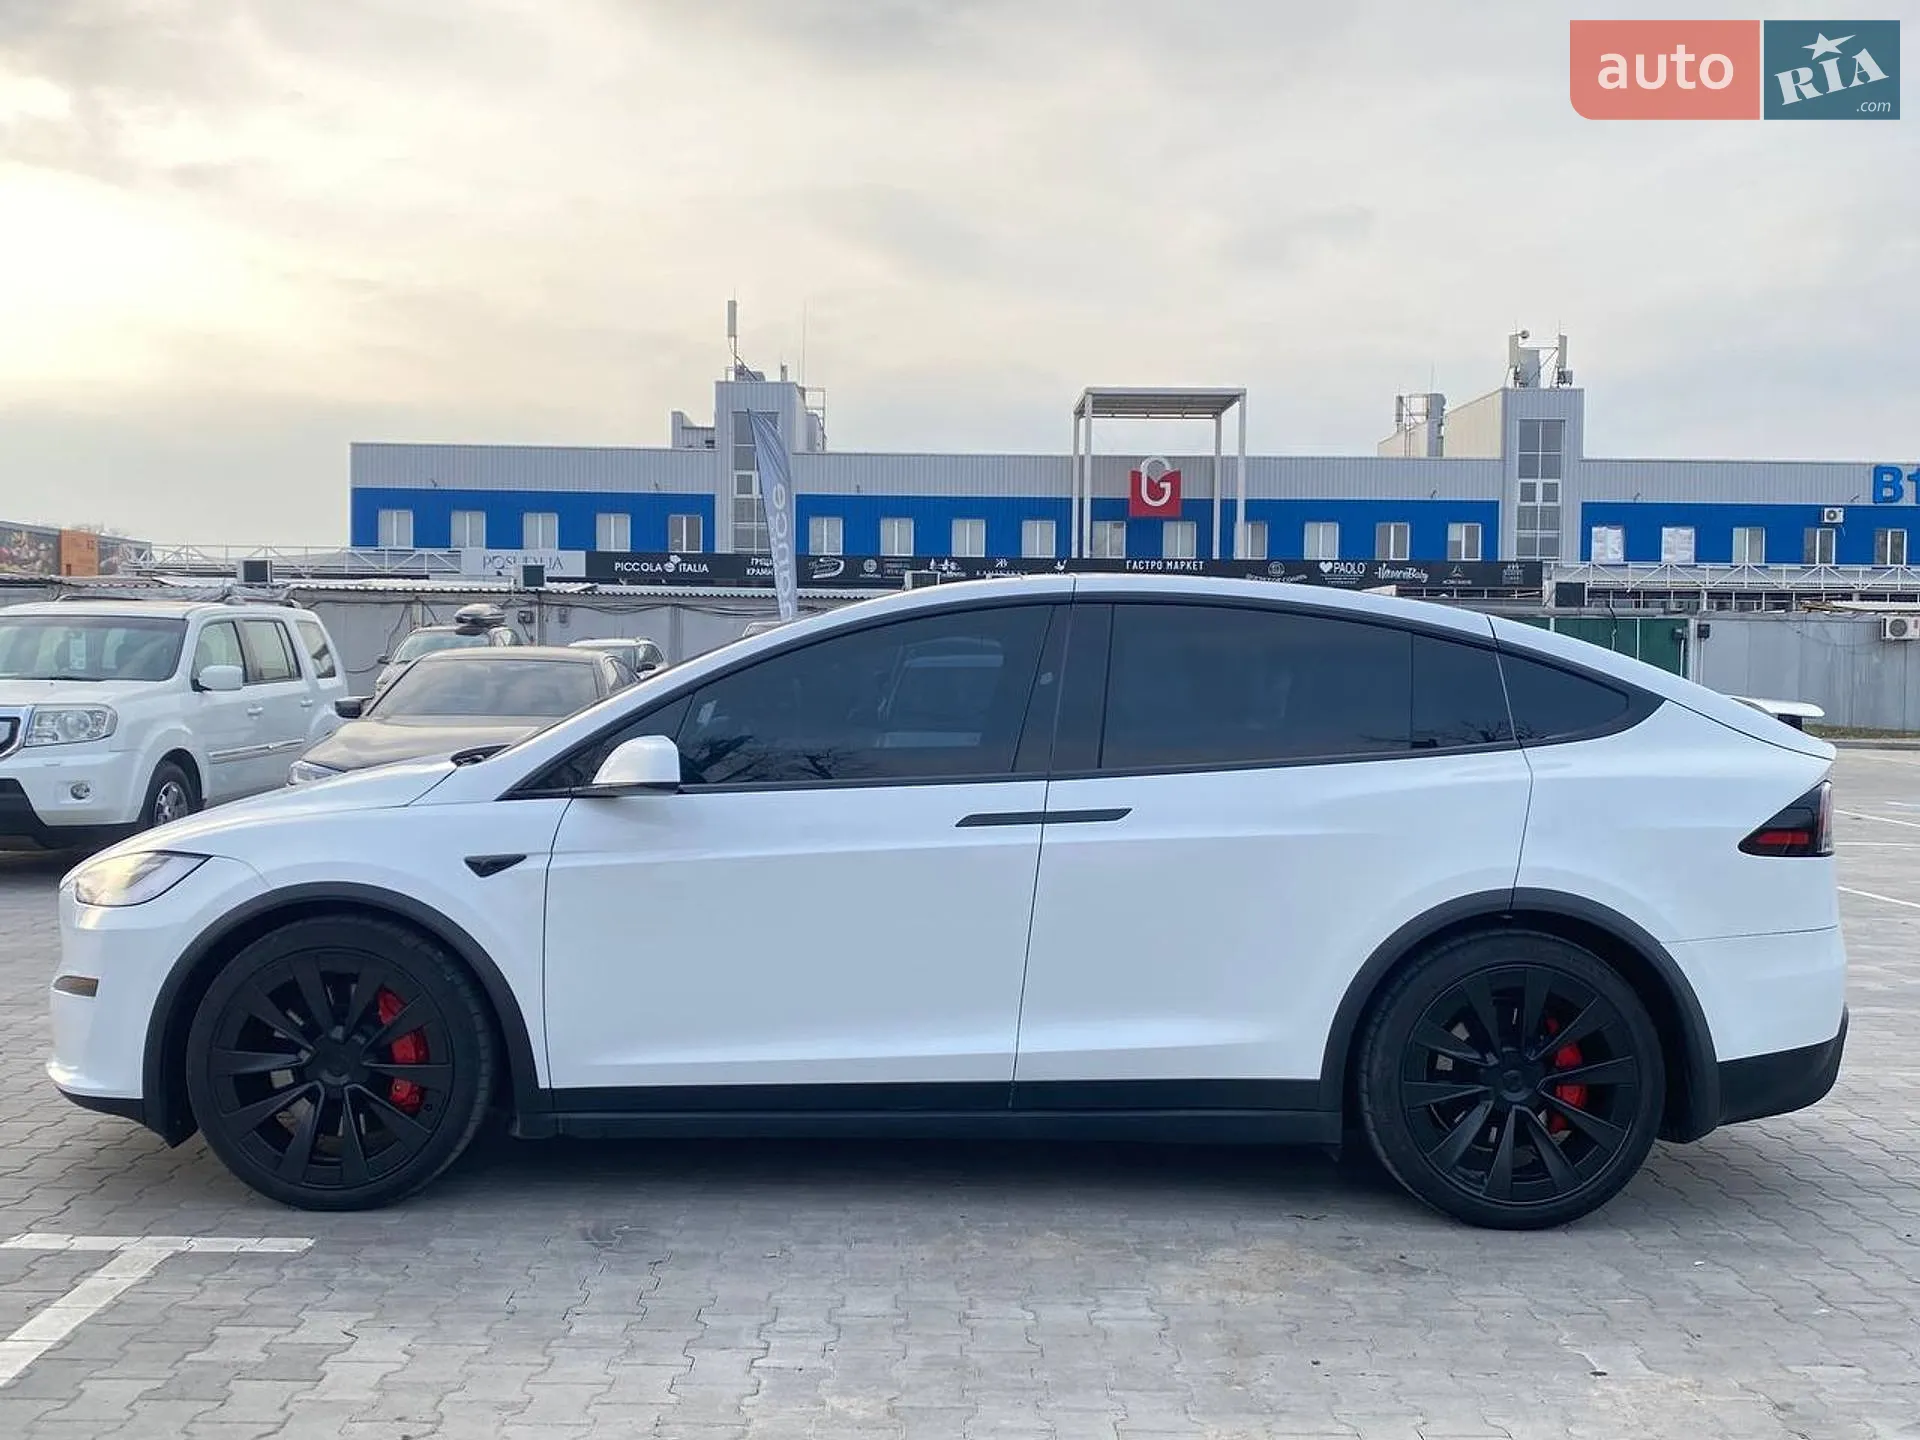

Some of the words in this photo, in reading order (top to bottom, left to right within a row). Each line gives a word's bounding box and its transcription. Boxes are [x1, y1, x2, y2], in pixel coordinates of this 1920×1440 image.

[614, 562, 663, 573] PICCOLA
[679, 563, 710, 573] ITALIA
[1126, 560, 1163, 570] ГАСТРО
[1167, 560, 1204, 571] МАРКЕТ
[1333, 562, 1366, 574] PAOLO
